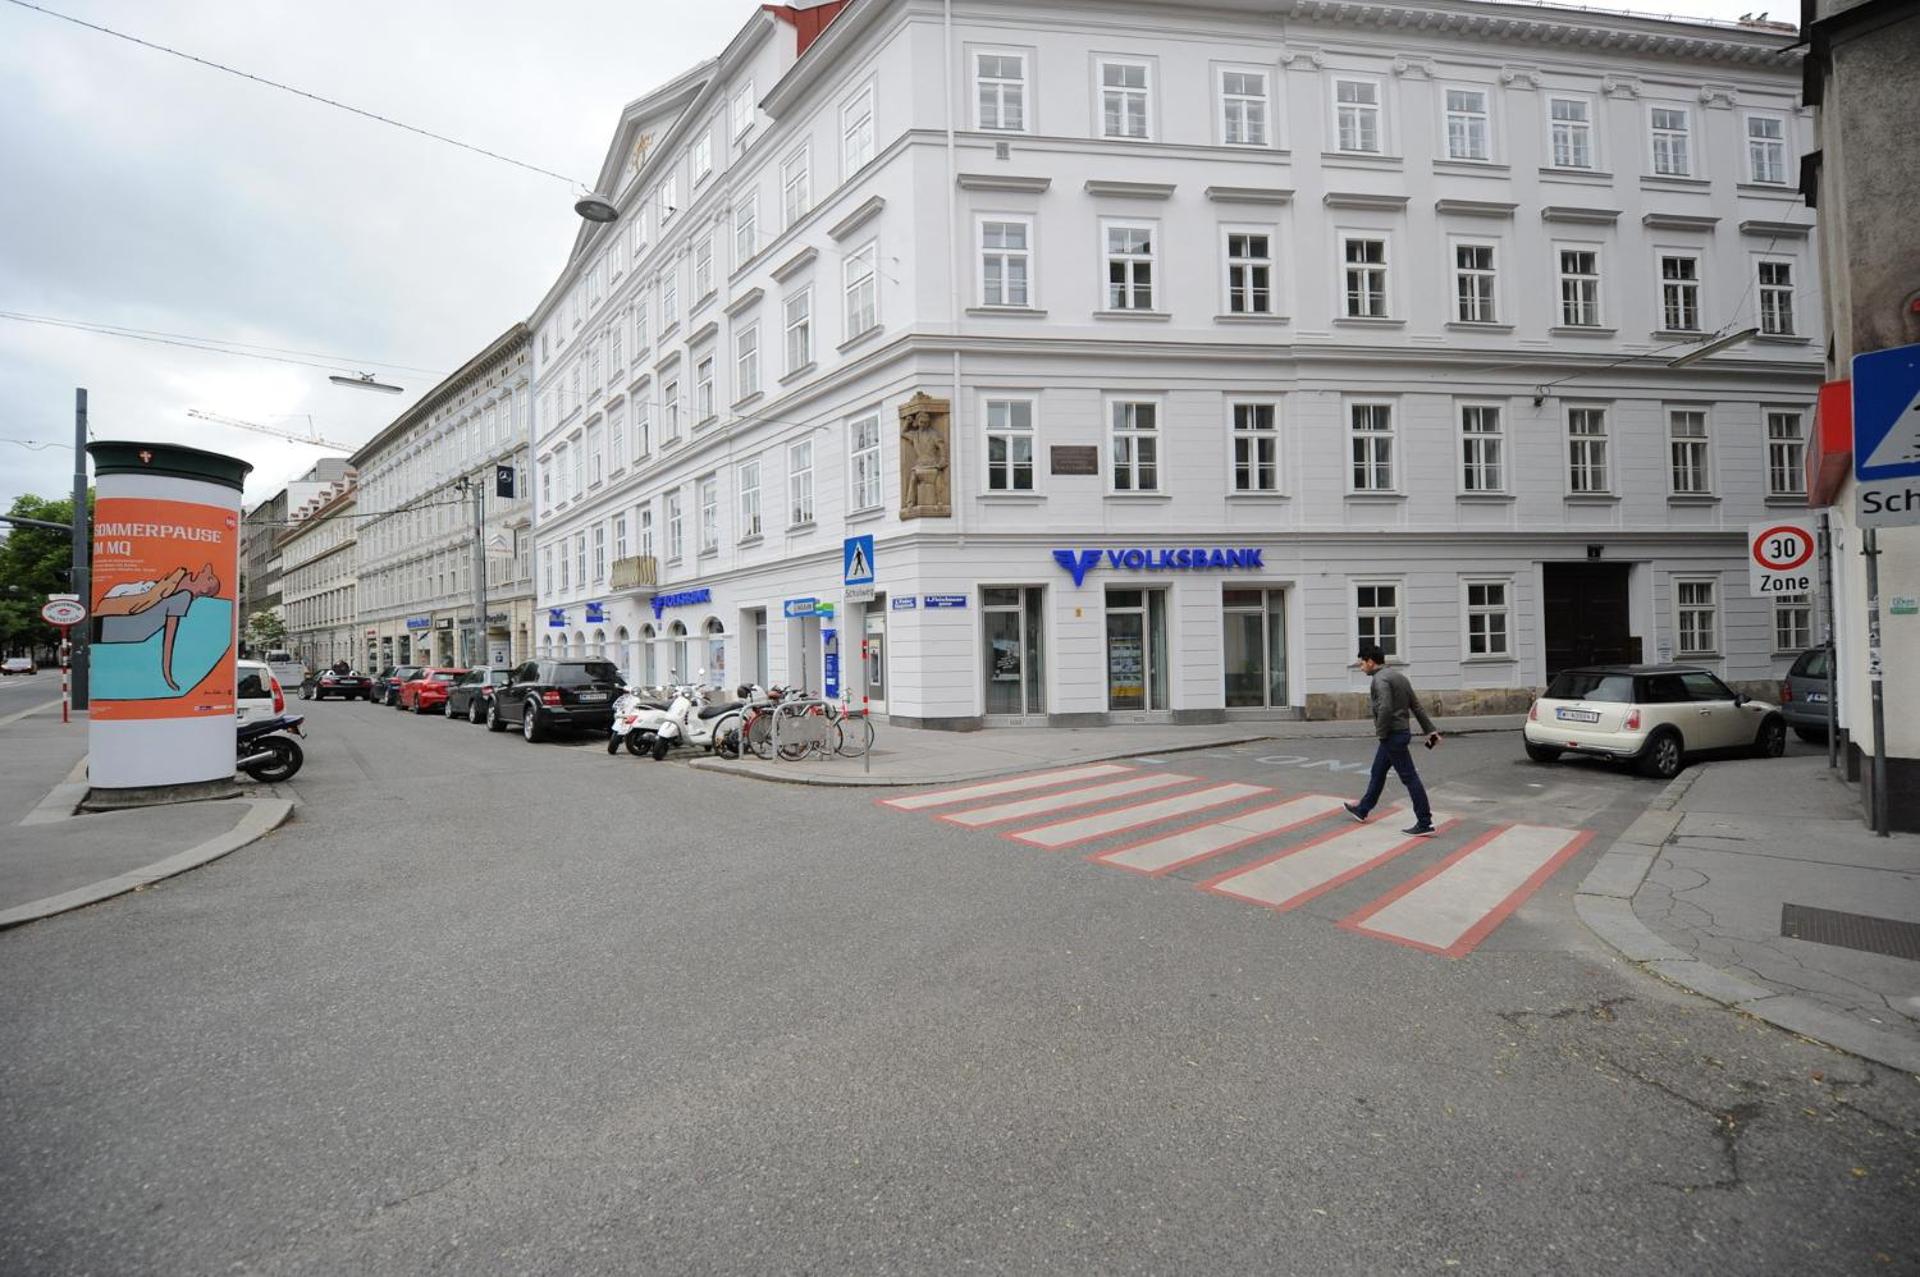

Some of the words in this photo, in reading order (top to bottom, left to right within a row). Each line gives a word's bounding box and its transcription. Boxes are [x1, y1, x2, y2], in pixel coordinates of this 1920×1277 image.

[94, 523, 222, 543] SOMMERPAUSE
[106, 541, 131, 556] MQ
[1770, 538, 1796, 558] 30
[1107, 549, 1264, 570] VOLKSBANK
[1760, 575, 1810, 592] Zone
